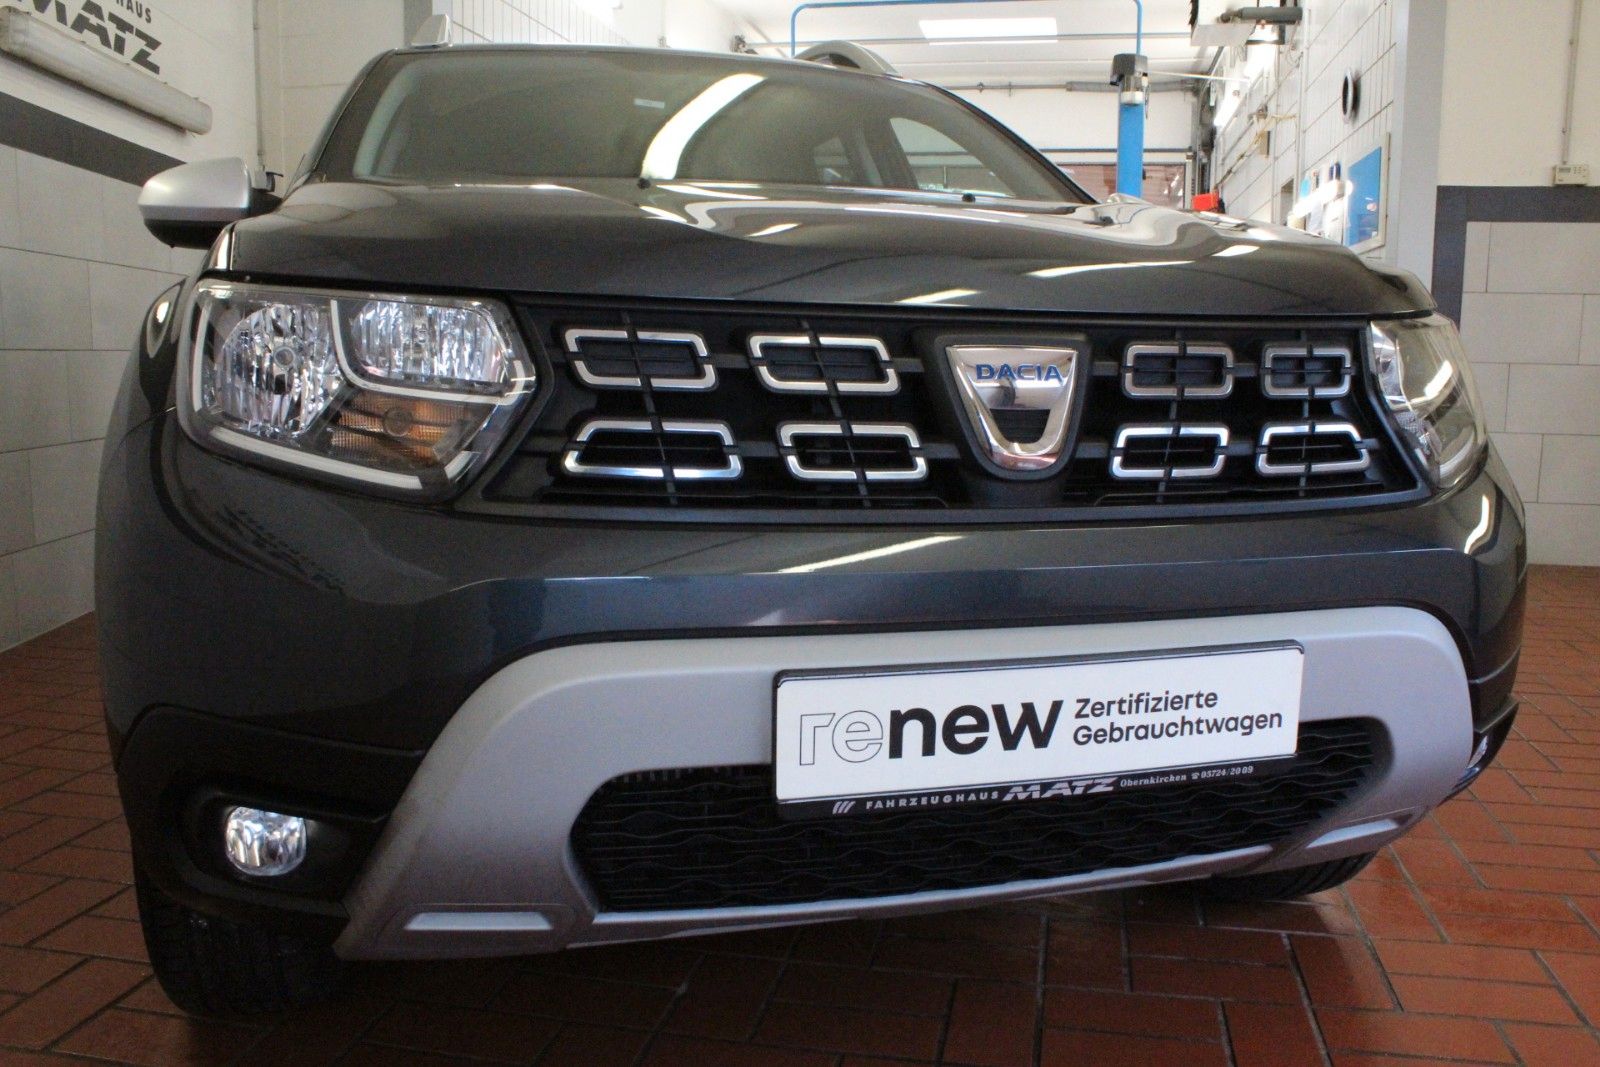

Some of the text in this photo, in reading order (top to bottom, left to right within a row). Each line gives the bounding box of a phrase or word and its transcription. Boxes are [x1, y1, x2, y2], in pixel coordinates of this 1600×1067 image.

[975, 363, 1063, 384] DACIA
[1075, 690, 1218, 719] Zertifizierte
[798, 699, 1064, 766] renew
[1073, 712, 1283, 747] Gebrauchtwagen
[865, 791, 999, 810] FAHRZEUGHAUS
[1002, 777, 1119, 801] MATZ
[1120, 774, 1187, 788] Obernkirchen
